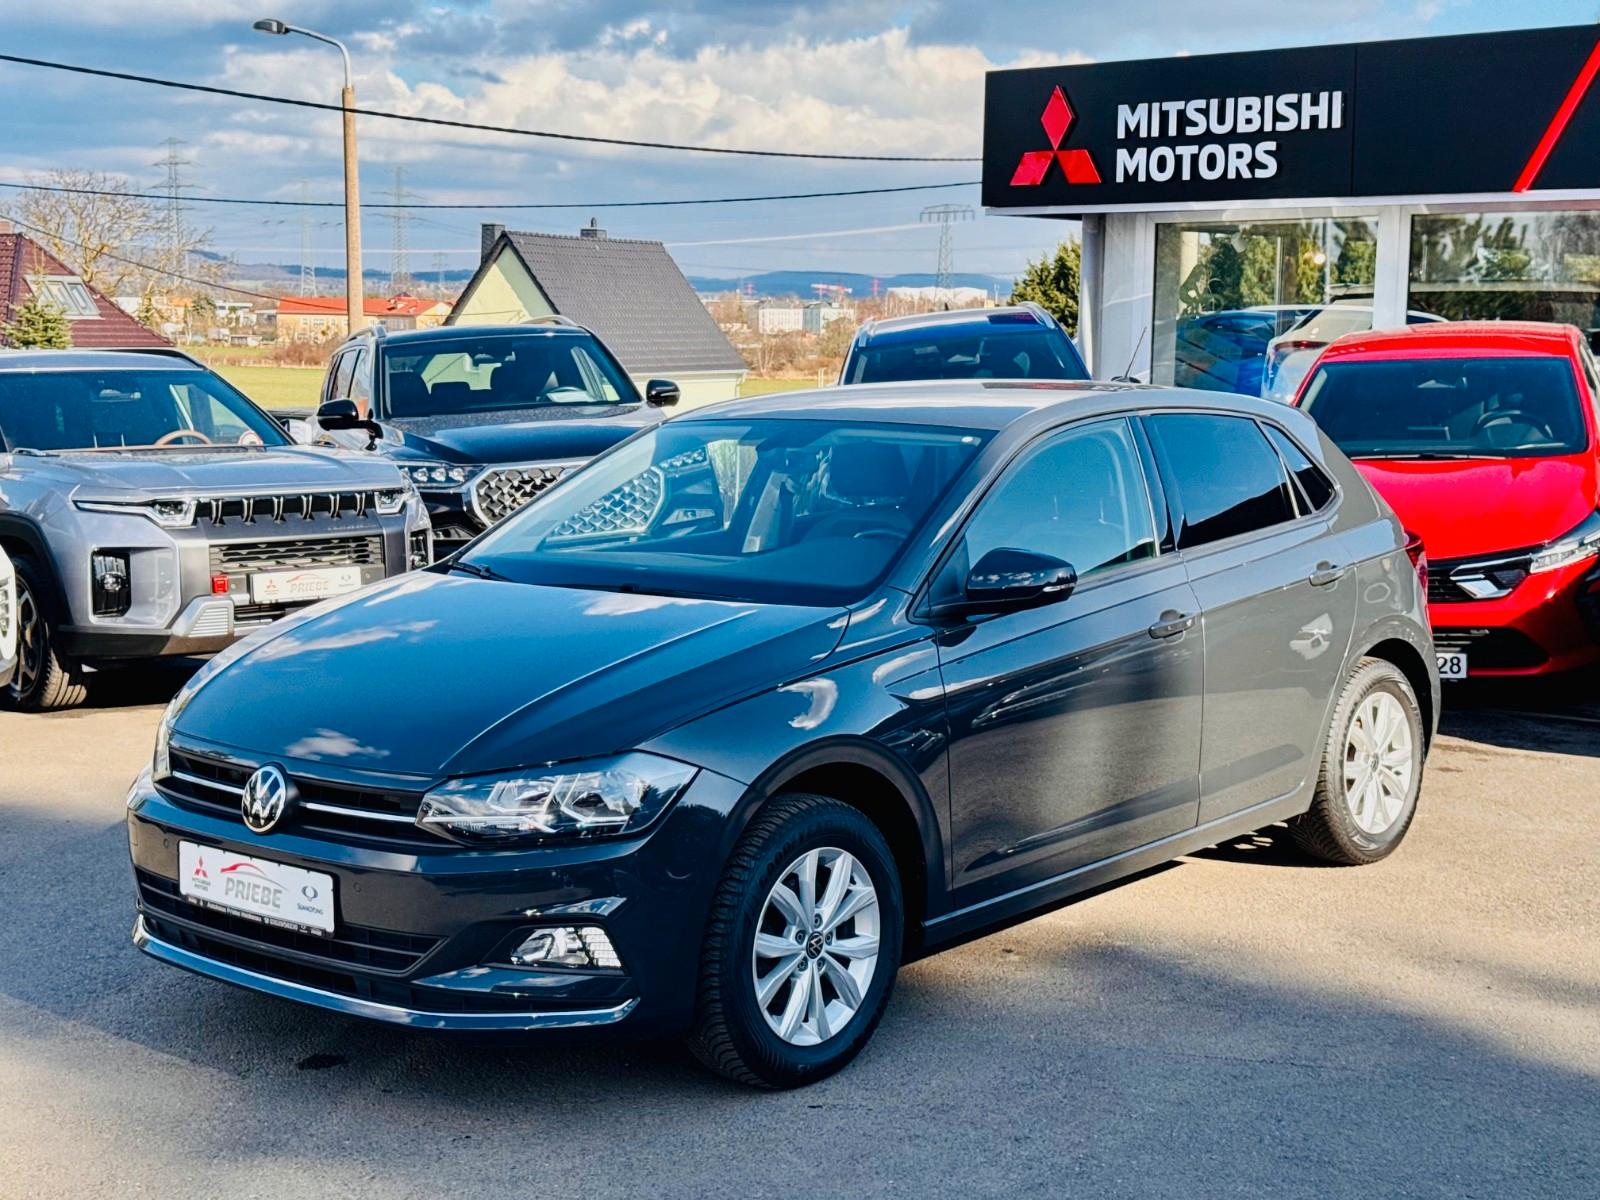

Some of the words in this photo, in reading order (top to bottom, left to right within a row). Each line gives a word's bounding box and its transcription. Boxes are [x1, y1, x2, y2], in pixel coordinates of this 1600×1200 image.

[1117, 90, 1343, 139] MITSUBISHI
[1116, 141, 1278, 183] MOTORS
[224, 877, 283, 909] PRIEBE
